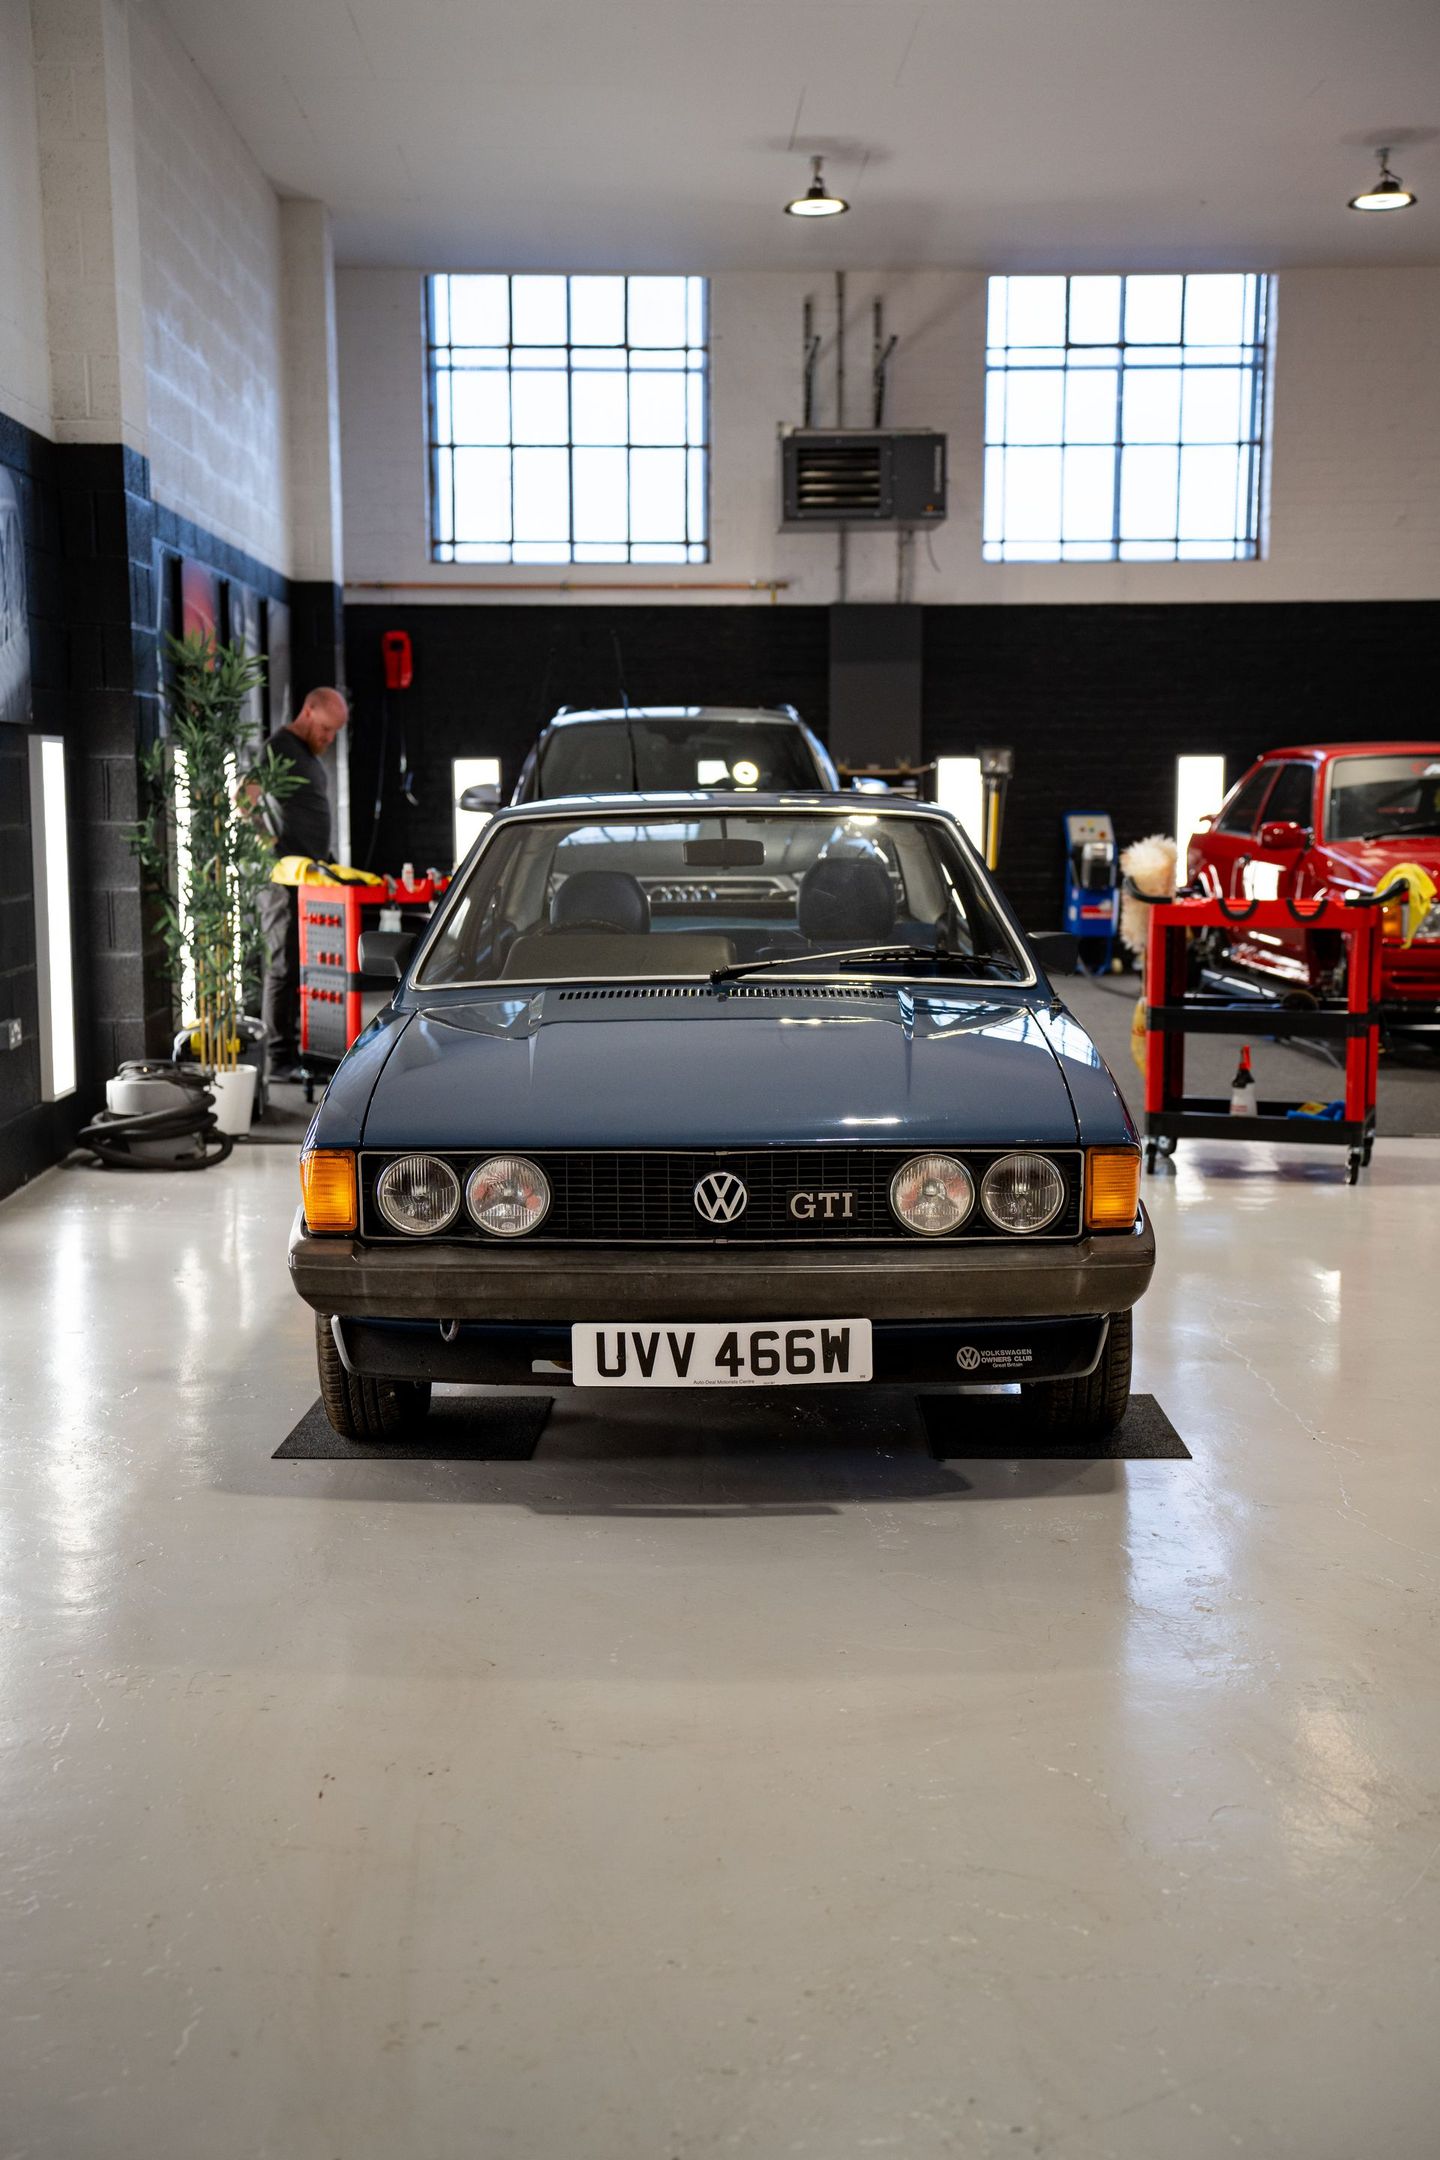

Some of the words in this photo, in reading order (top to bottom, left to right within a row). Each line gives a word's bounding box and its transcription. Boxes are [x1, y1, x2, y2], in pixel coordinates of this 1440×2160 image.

[695, 1172, 747, 1223] VW
[790, 1192, 853, 1219] GTI
[595, 1331, 696, 1378] UVV
[714, 1327, 850, 1377] 466W
